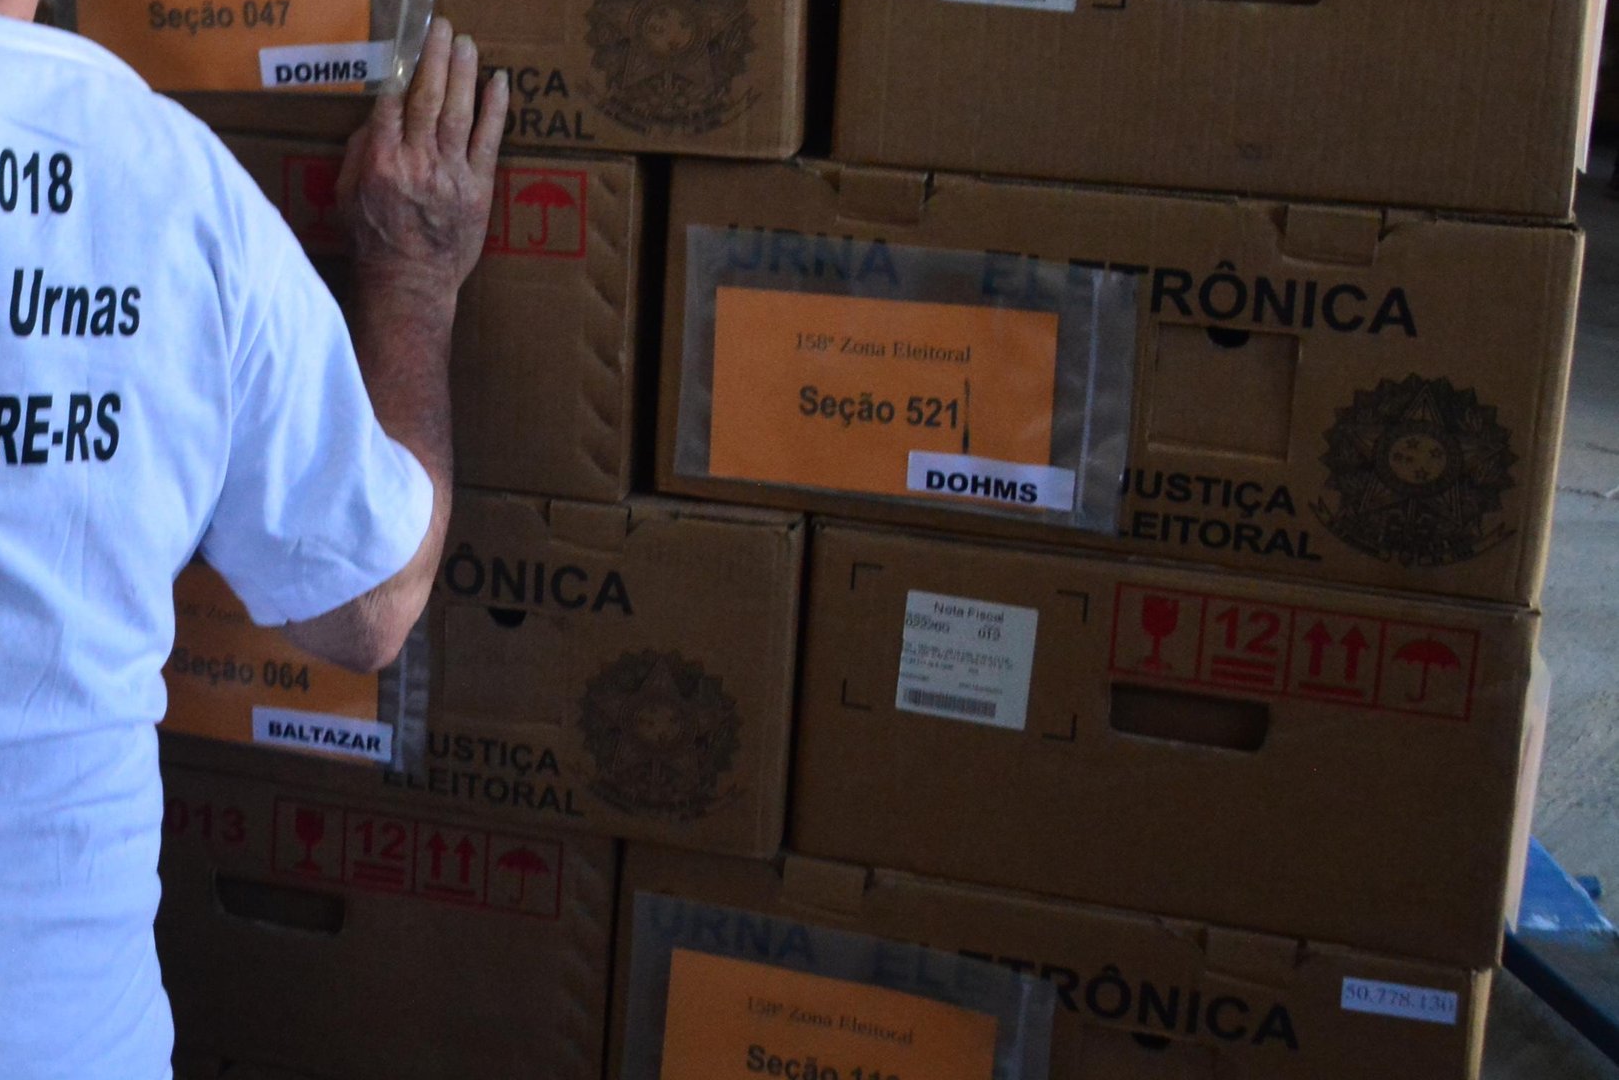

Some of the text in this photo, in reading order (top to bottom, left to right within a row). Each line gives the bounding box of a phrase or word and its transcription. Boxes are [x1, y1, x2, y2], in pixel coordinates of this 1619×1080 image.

[147, 0, 234, 35] Seção
[274, 59, 368, 84] DOHMS
[9, 268, 142, 339] Urnas
[839, 336, 886, 357] Zona
[893, 339, 972, 364] Eleitoral
[799, 385, 961, 429] Seção 521
[925, 470, 1039, 504] DOHMS
[1213, 610, 1280, 657] 12
[268, 721, 382, 753] BALTAZAR
[788, 1005, 833, 1029] Zona
